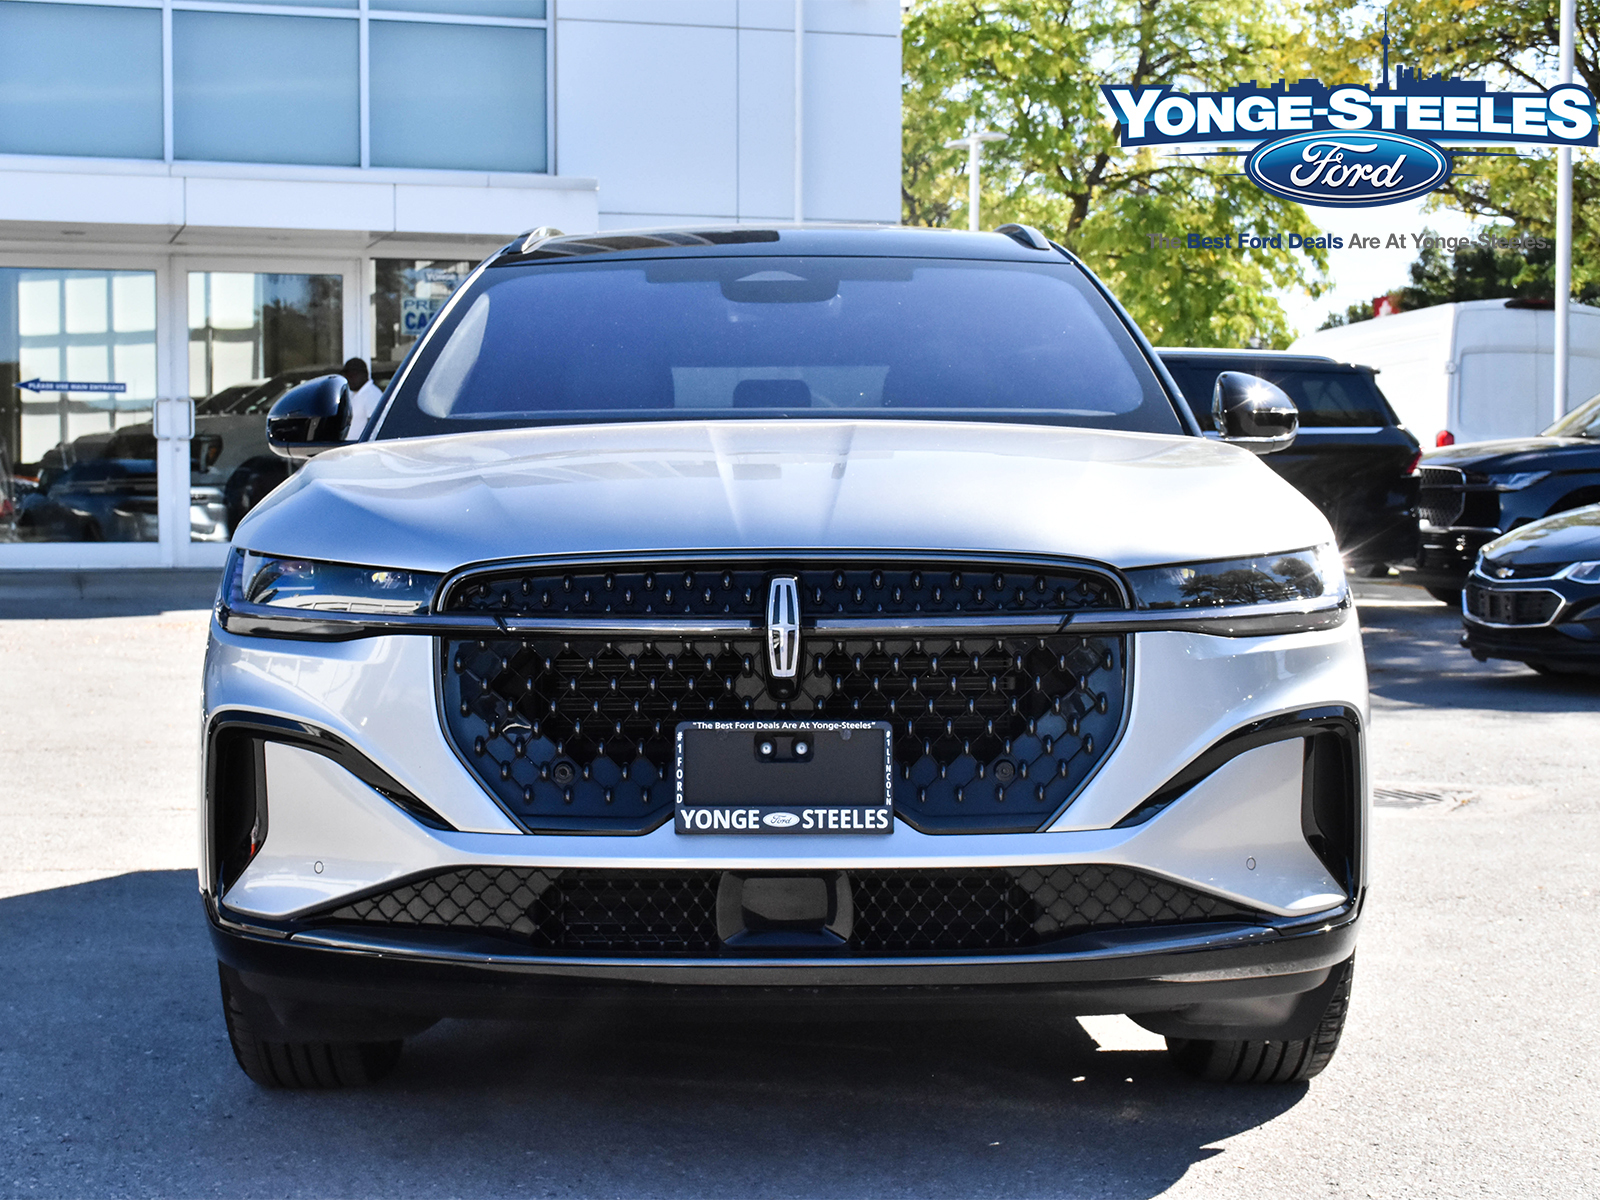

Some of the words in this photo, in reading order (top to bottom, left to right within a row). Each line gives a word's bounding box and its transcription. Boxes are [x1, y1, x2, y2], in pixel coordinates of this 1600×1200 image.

[715, 721, 733, 730] Best
[735, 721, 754, 730] Ford
[757, 721, 780, 730] Deals
[781, 721, 798, 730] Are
[799, 721, 810, 730] At
[680, 809, 760, 829] YONGE
[770, 815, 793, 825] Ford
[802, 809, 889, 829] STEELES
